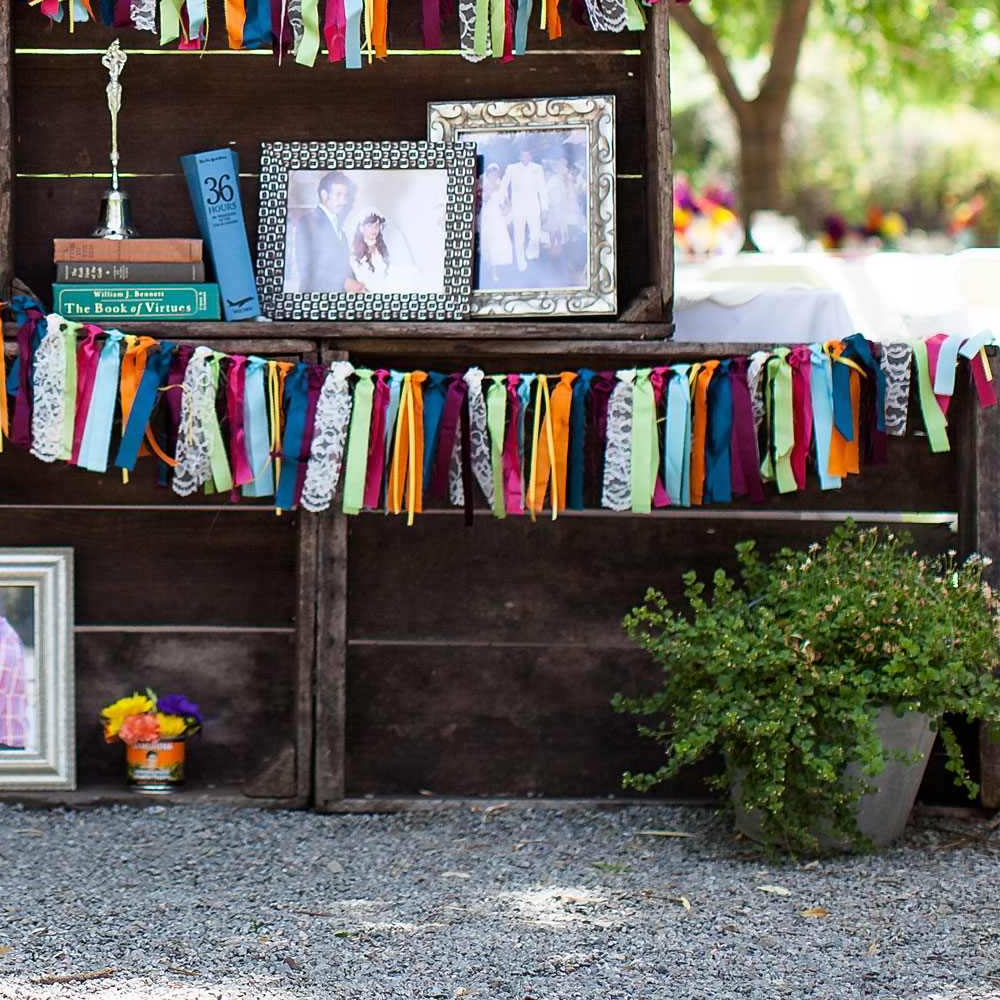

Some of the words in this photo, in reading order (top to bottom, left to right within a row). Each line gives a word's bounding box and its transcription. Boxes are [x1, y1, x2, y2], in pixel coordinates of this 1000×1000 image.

[204, 174, 234, 205] 36
[208, 202, 237, 214] HOURS
[93, 290, 124, 298] William
[125, 290, 133, 299] J.
[134, 290, 165, 298] Bennett
[64, 302, 91, 314] The
[94, 302, 127, 314] Book
[130, 302, 143, 316] of
[144, 301, 192, 313] Virtues
